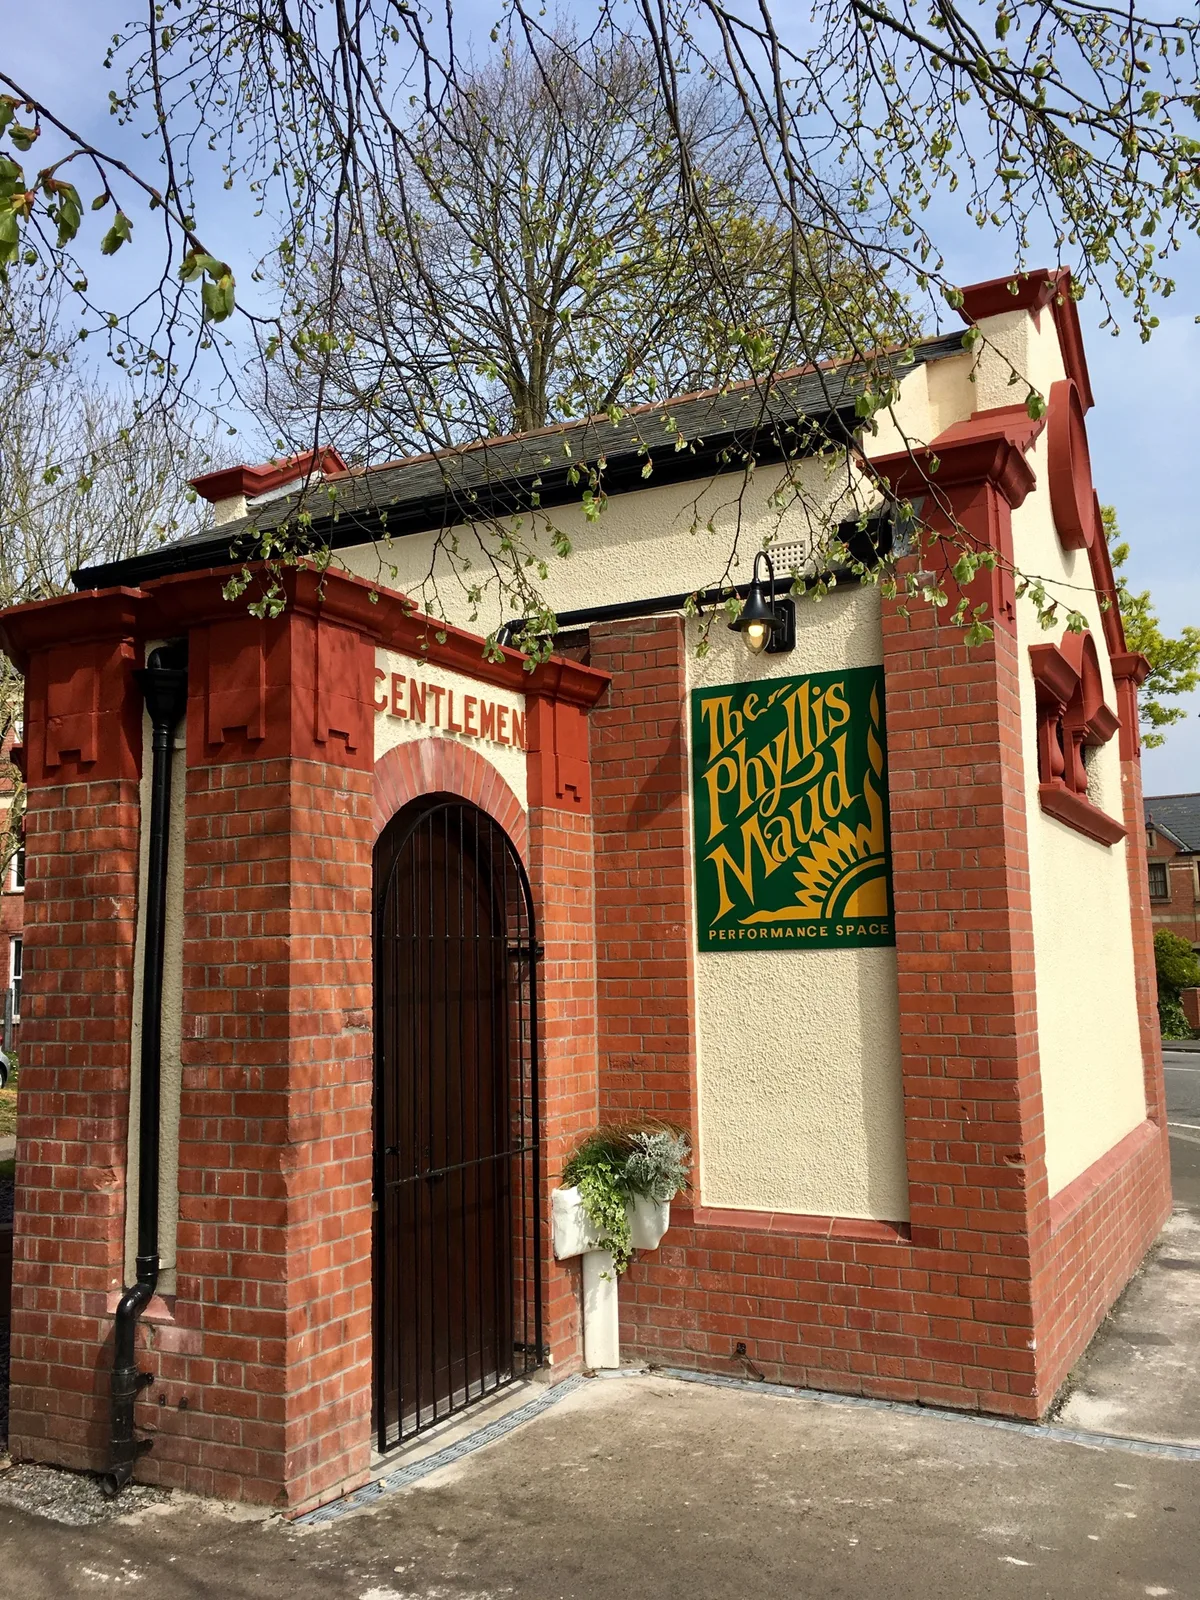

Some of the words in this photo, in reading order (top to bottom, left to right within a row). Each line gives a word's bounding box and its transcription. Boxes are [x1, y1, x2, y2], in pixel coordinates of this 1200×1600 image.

[701, 688, 770, 765] The
[703, 731, 862, 926] Maud
[708, 926, 828, 941] PERFORMANCE
[836, 923, 889, 936] SPACE
